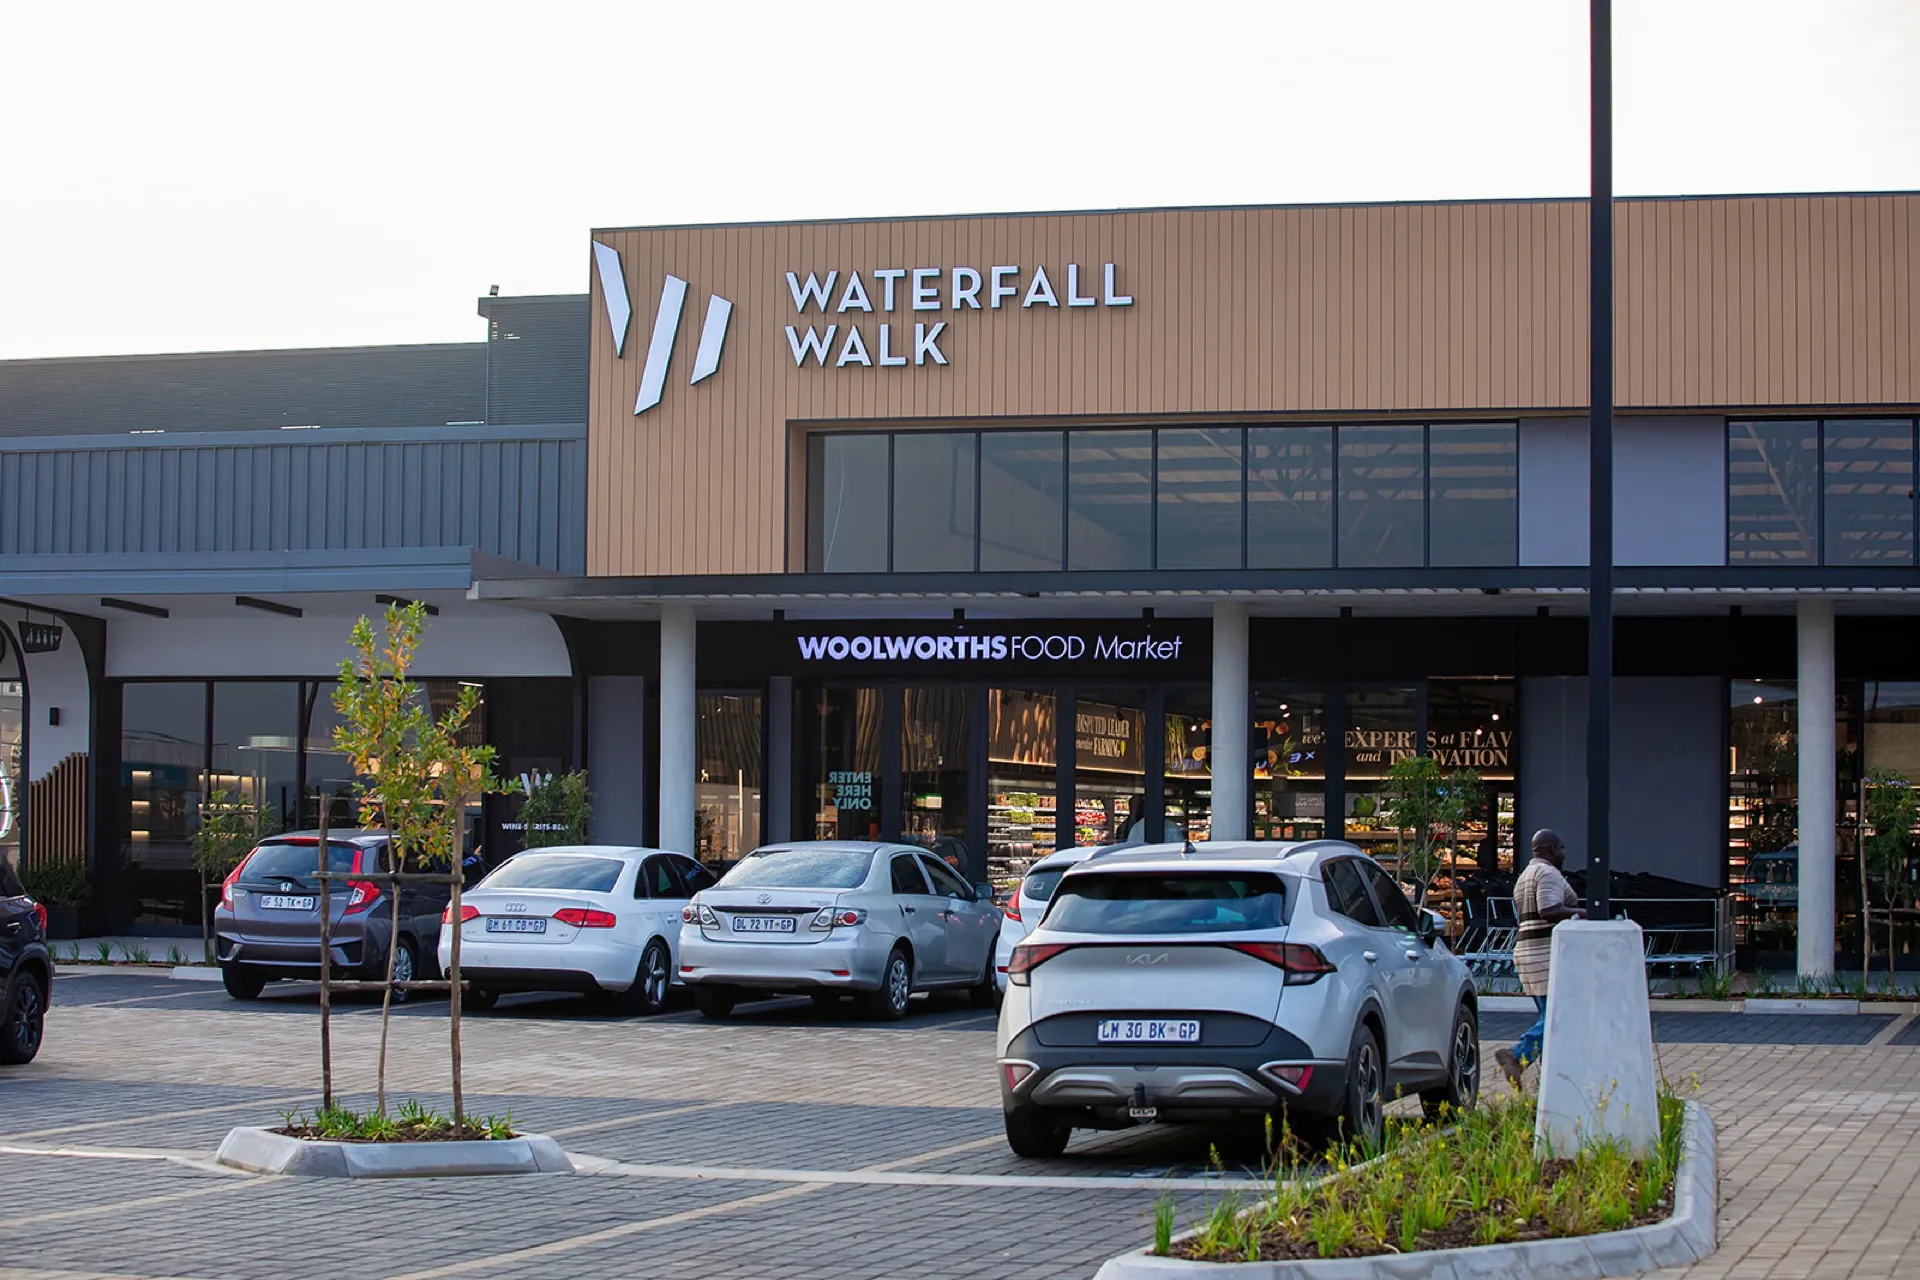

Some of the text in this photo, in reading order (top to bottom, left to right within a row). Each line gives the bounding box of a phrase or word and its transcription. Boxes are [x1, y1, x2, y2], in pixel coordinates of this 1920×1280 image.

[785, 263, 1133, 313] WATERFALL
[785, 321, 949, 367] WALK
[798, 635, 1182, 660] WOOLWORTHS FOOD Market
[1440, 734, 1455, 745] at
[1356, 750, 1382, 762] and
[533, 921, 545, 931] GP
[750, 919, 760, 930] 72
[780, 919, 793, 931] GP
[1102, 1022, 1196, 1039] LM 30 BK GP
